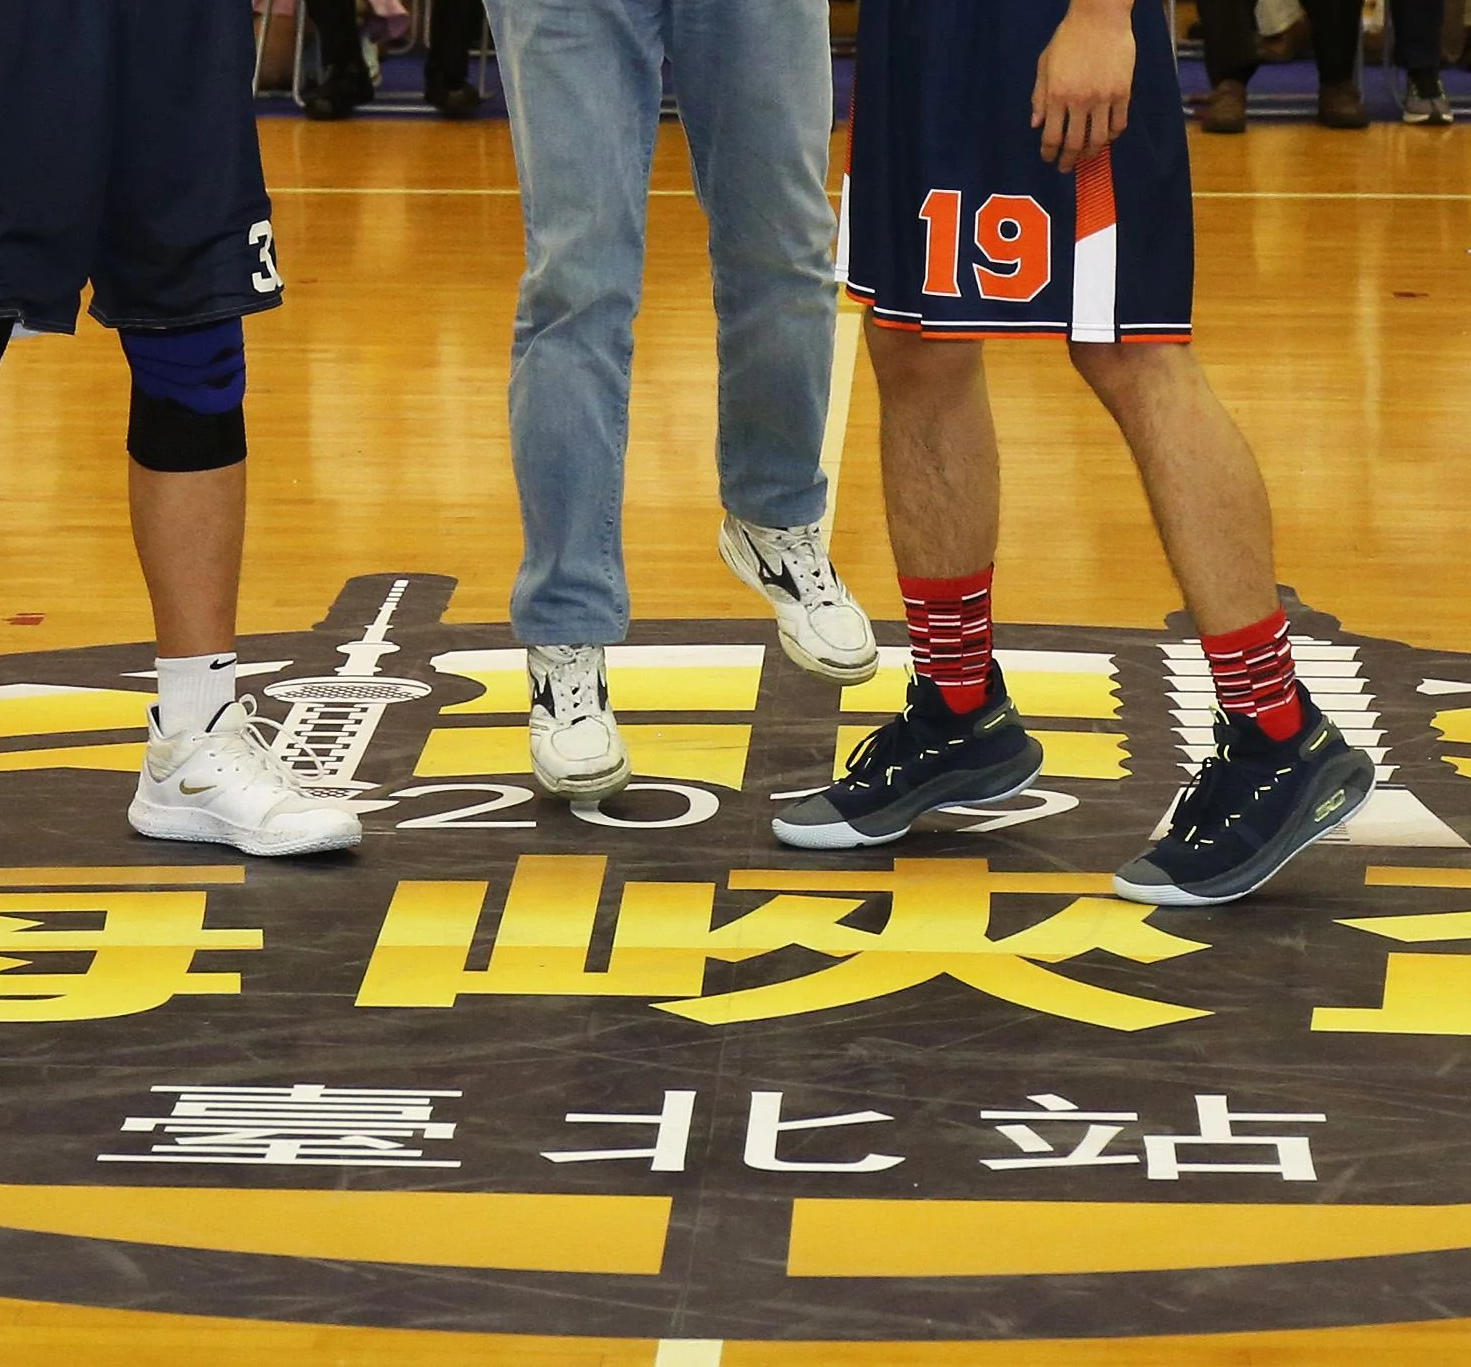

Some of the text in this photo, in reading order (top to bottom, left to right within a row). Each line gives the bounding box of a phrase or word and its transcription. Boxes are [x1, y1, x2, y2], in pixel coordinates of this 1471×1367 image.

[918, 189, 1052, 303] 19
[96, 1083, 1327, 1182] 臺北站
